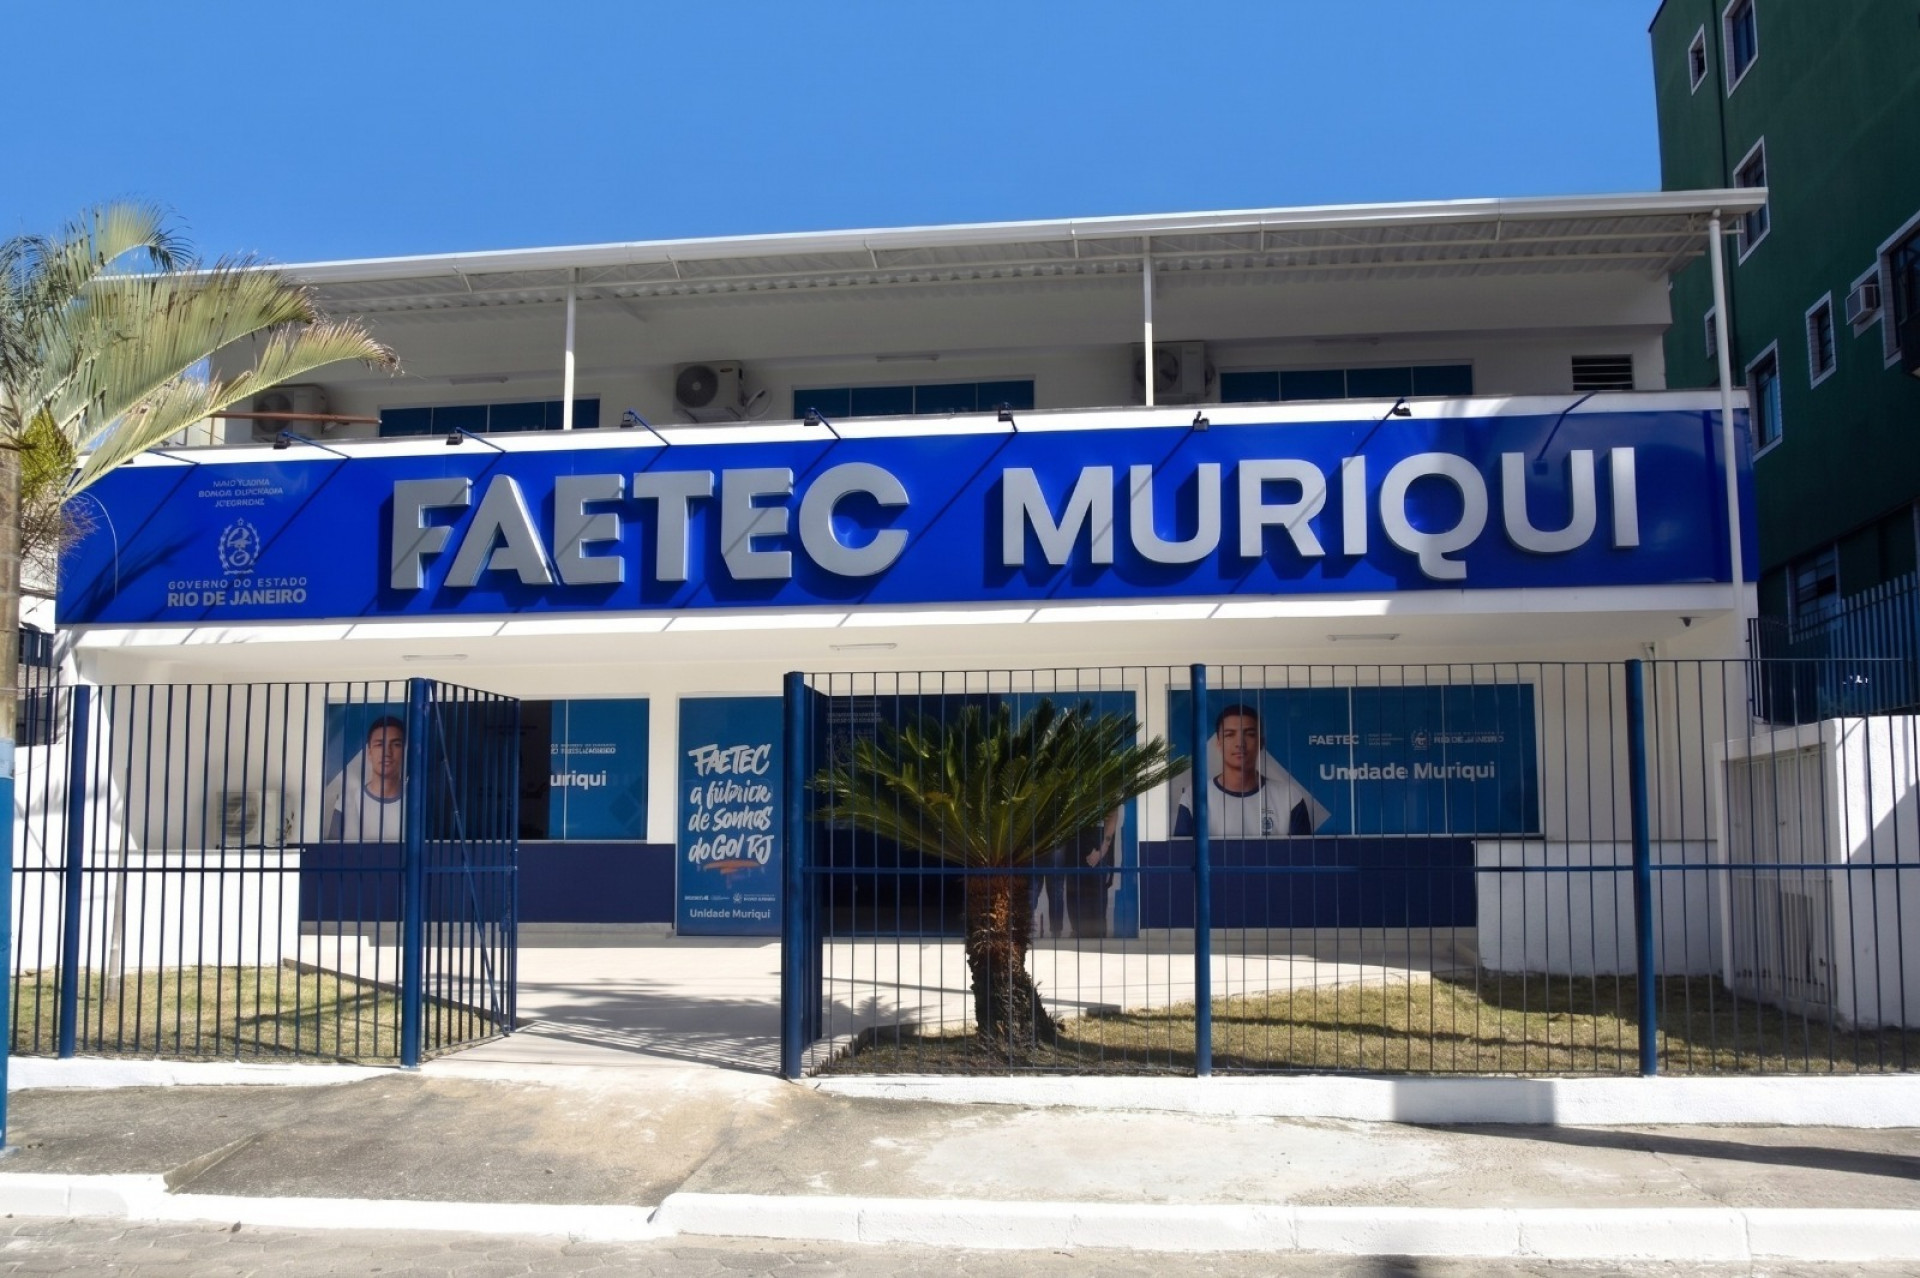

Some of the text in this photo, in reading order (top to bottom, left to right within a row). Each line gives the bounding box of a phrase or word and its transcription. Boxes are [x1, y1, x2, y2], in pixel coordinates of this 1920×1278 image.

[391, 446, 1640, 590] FAETEC MURIQUI
[168, 576, 307, 590] GOVERNO DO ESTADO
[167, 588, 307, 607] RIO DE JANEIRO
[1308, 735, 1359, 745] FAETEC
[688, 744, 772, 777] FAETEC
[550, 770, 607, 790] uriqui
[1414, 761, 1495, 781] Muriqui
[690, 786, 702, 805] a
[688, 805, 710, 832] de
[688, 837, 710, 864] do
[690, 908, 771, 920] Unidade Muriqui
